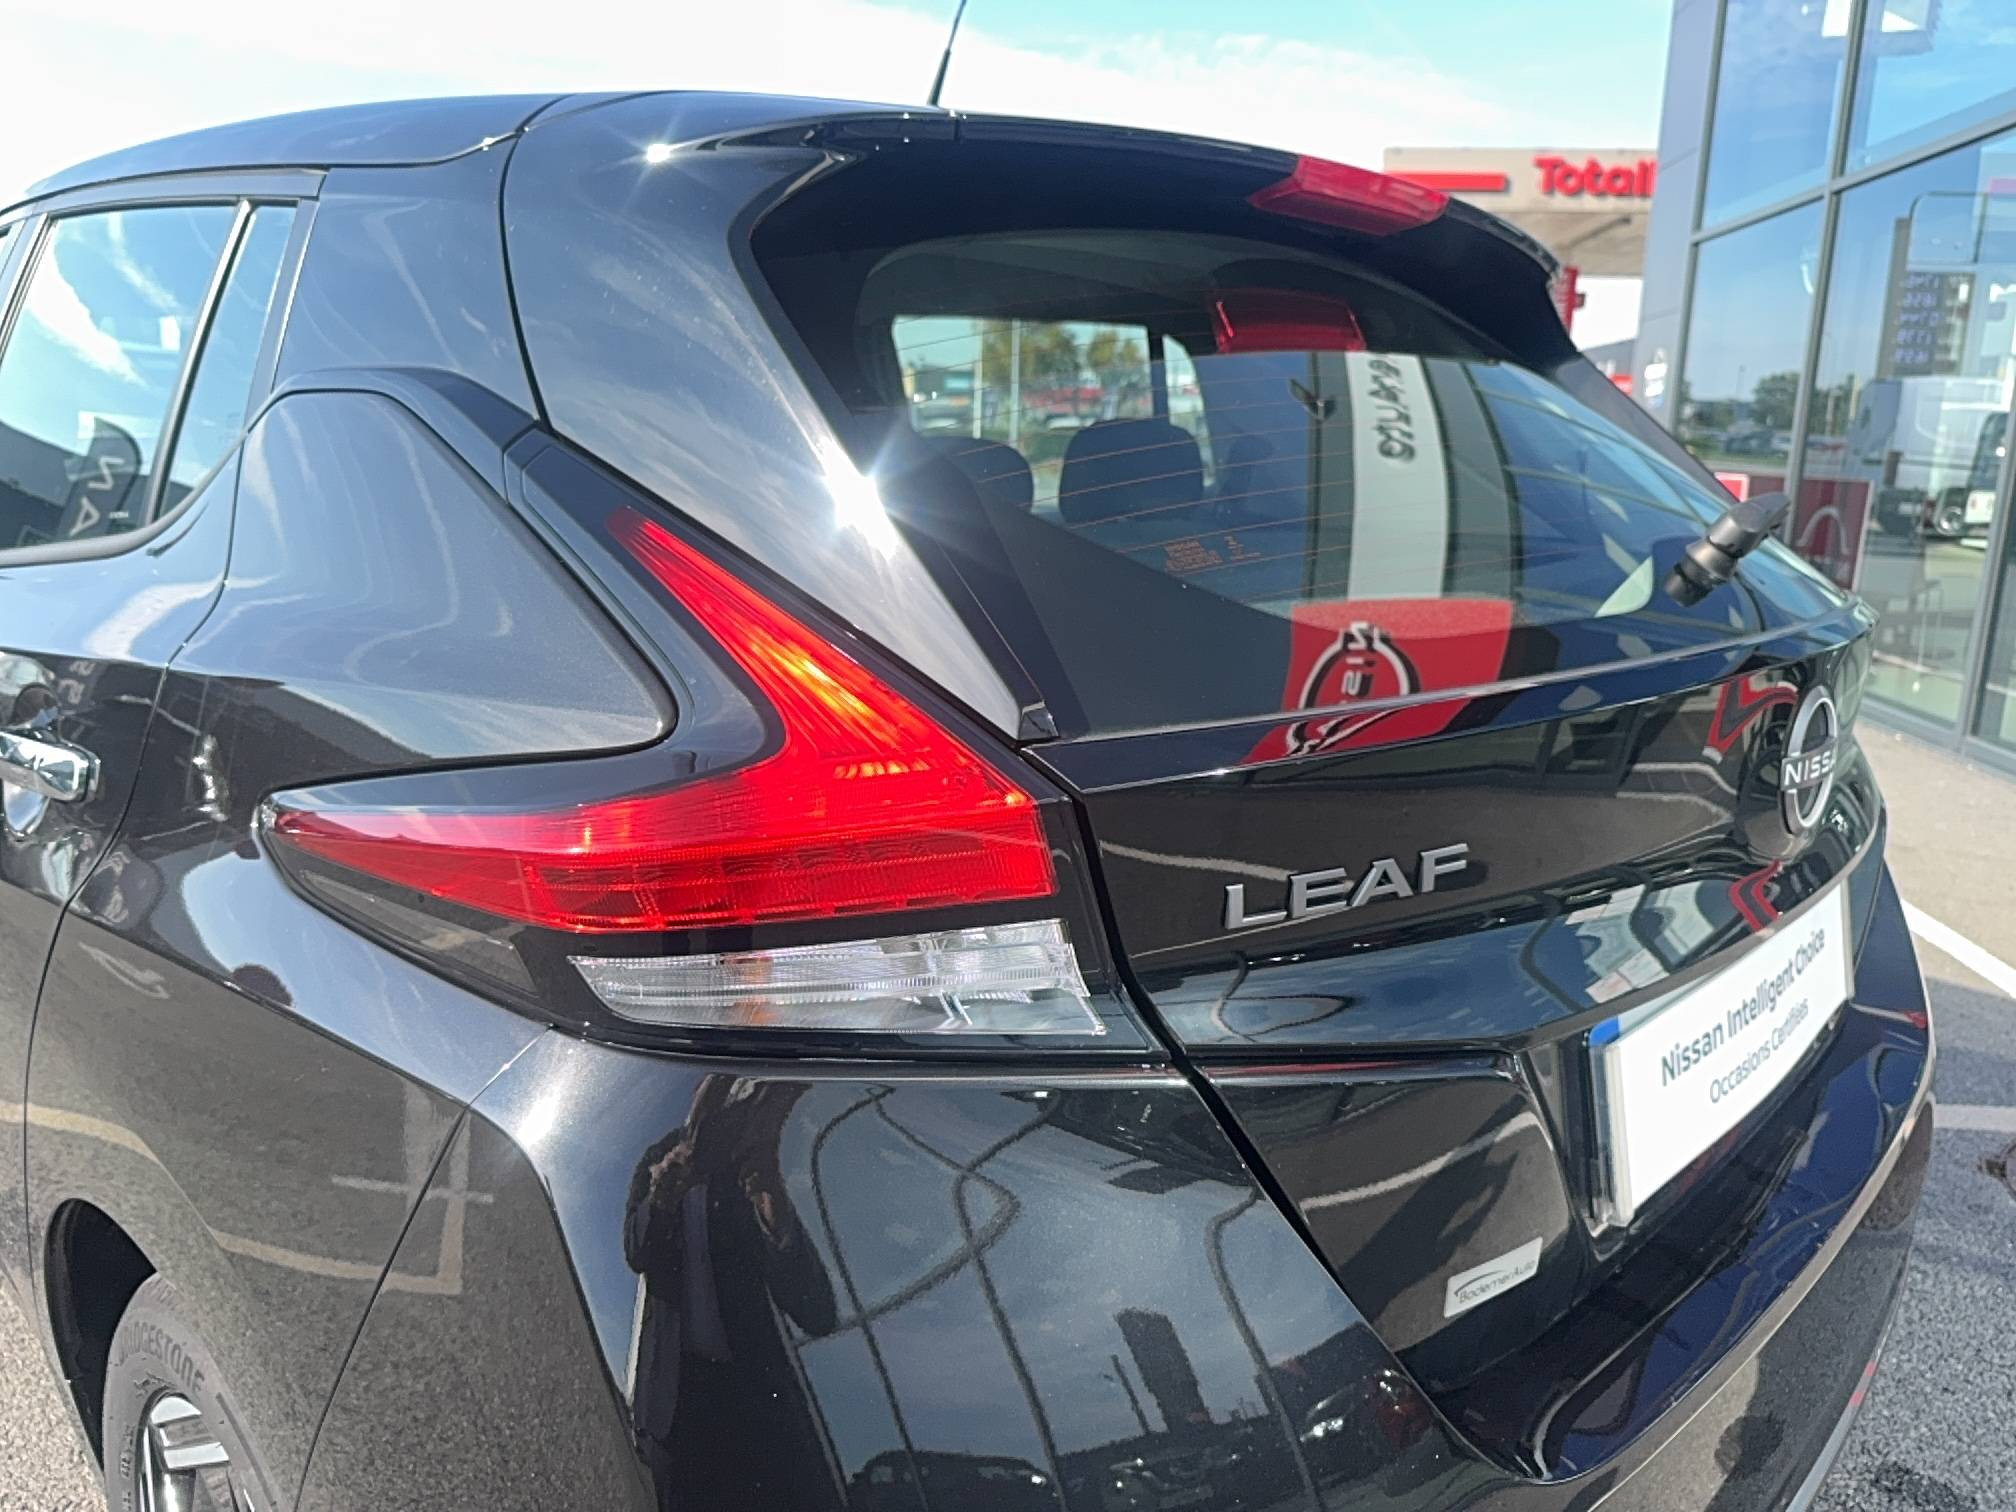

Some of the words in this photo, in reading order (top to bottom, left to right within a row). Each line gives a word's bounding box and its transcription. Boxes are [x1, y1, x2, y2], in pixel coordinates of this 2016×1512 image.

[1534, 154, 1657, 197] Total
[1224, 843, 1469, 930] LEAF
[1661, 1022, 1724, 1087] Nissan
[1727, 959, 1795, 1038] Intelligent
[1794, 928, 1825, 976] Choice
[1709, 1039, 1771, 1104] Occasions
